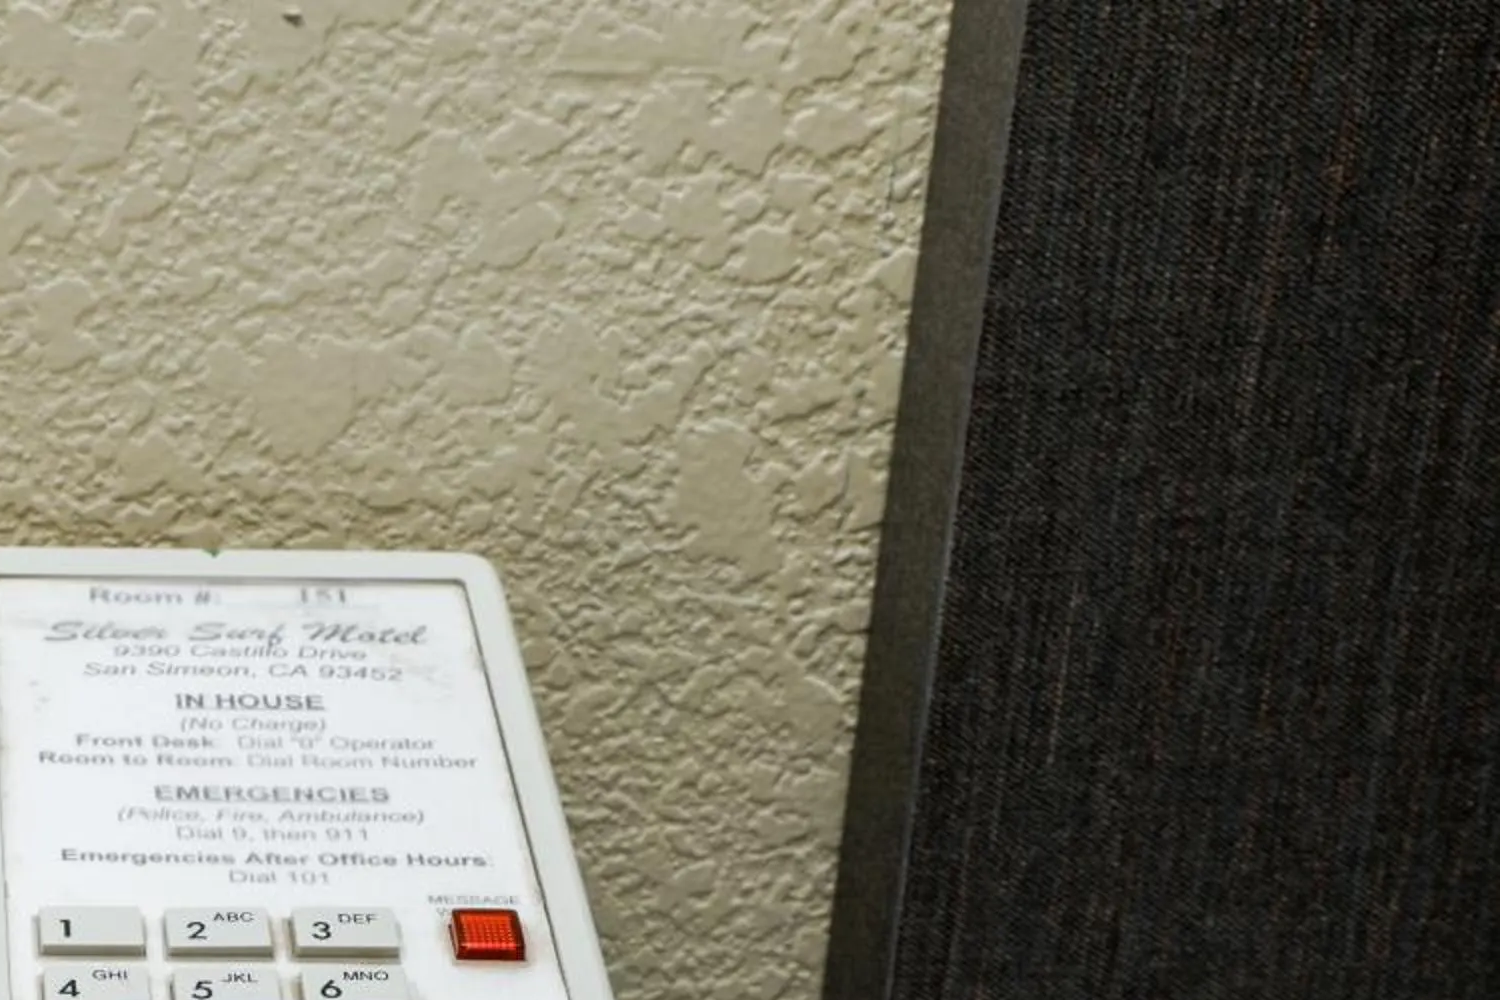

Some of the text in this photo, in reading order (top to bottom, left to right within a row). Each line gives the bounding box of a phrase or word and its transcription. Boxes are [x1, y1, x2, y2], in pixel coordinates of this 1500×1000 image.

[89, 587, 182, 604] Room
[300, 588, 347, 604] 151
[43, 621, 427, 650] Silver Surf Motel
[113, 645, 367, 661] 9390 Castillo Drive
[83, 661, 403, 682] San Simeon, CA 93452
[175, 694, 325, 712] IN HOUSE
[180, 716, 327, 733] (No Charge)
[75, 733, 143, 748] Front
[237, 735, 283, 749] Dial
[329, 736, 436, 752] Operator
[38, 751, 115, 765] Room
[122, 753, 149, 766] to
[247, 754, 294, 768] Dial
[301, 754, 374, 769] Room
[380, 755, 478, 769] Number
[153, 785, 391, 803] EMERGENCIES
[278, 807, 425, 825] Ambulance)
[176, 826, 222, 841] Dial
[262, 828, 318, 842] then
[324, 828, 368, 842] 911
[60, 848, 236, 867] Emergencies
[244, 851, 309, 866] After
[317, 852, 397, 867] Office
[229, 870, 330, 886] Dial 101
[427, 894, 520, 905] MESSAGE
[59, 919, 72, 938] 1
[186, 911, 255, 940] 2 ABC
[311, 913, 378, 940] 3 DEF
[58, 969, 129, 997] 4 GHI
[191, 972, 259, 1000] 5 JKL
[320, 971, 389, 999] 6 MNO
